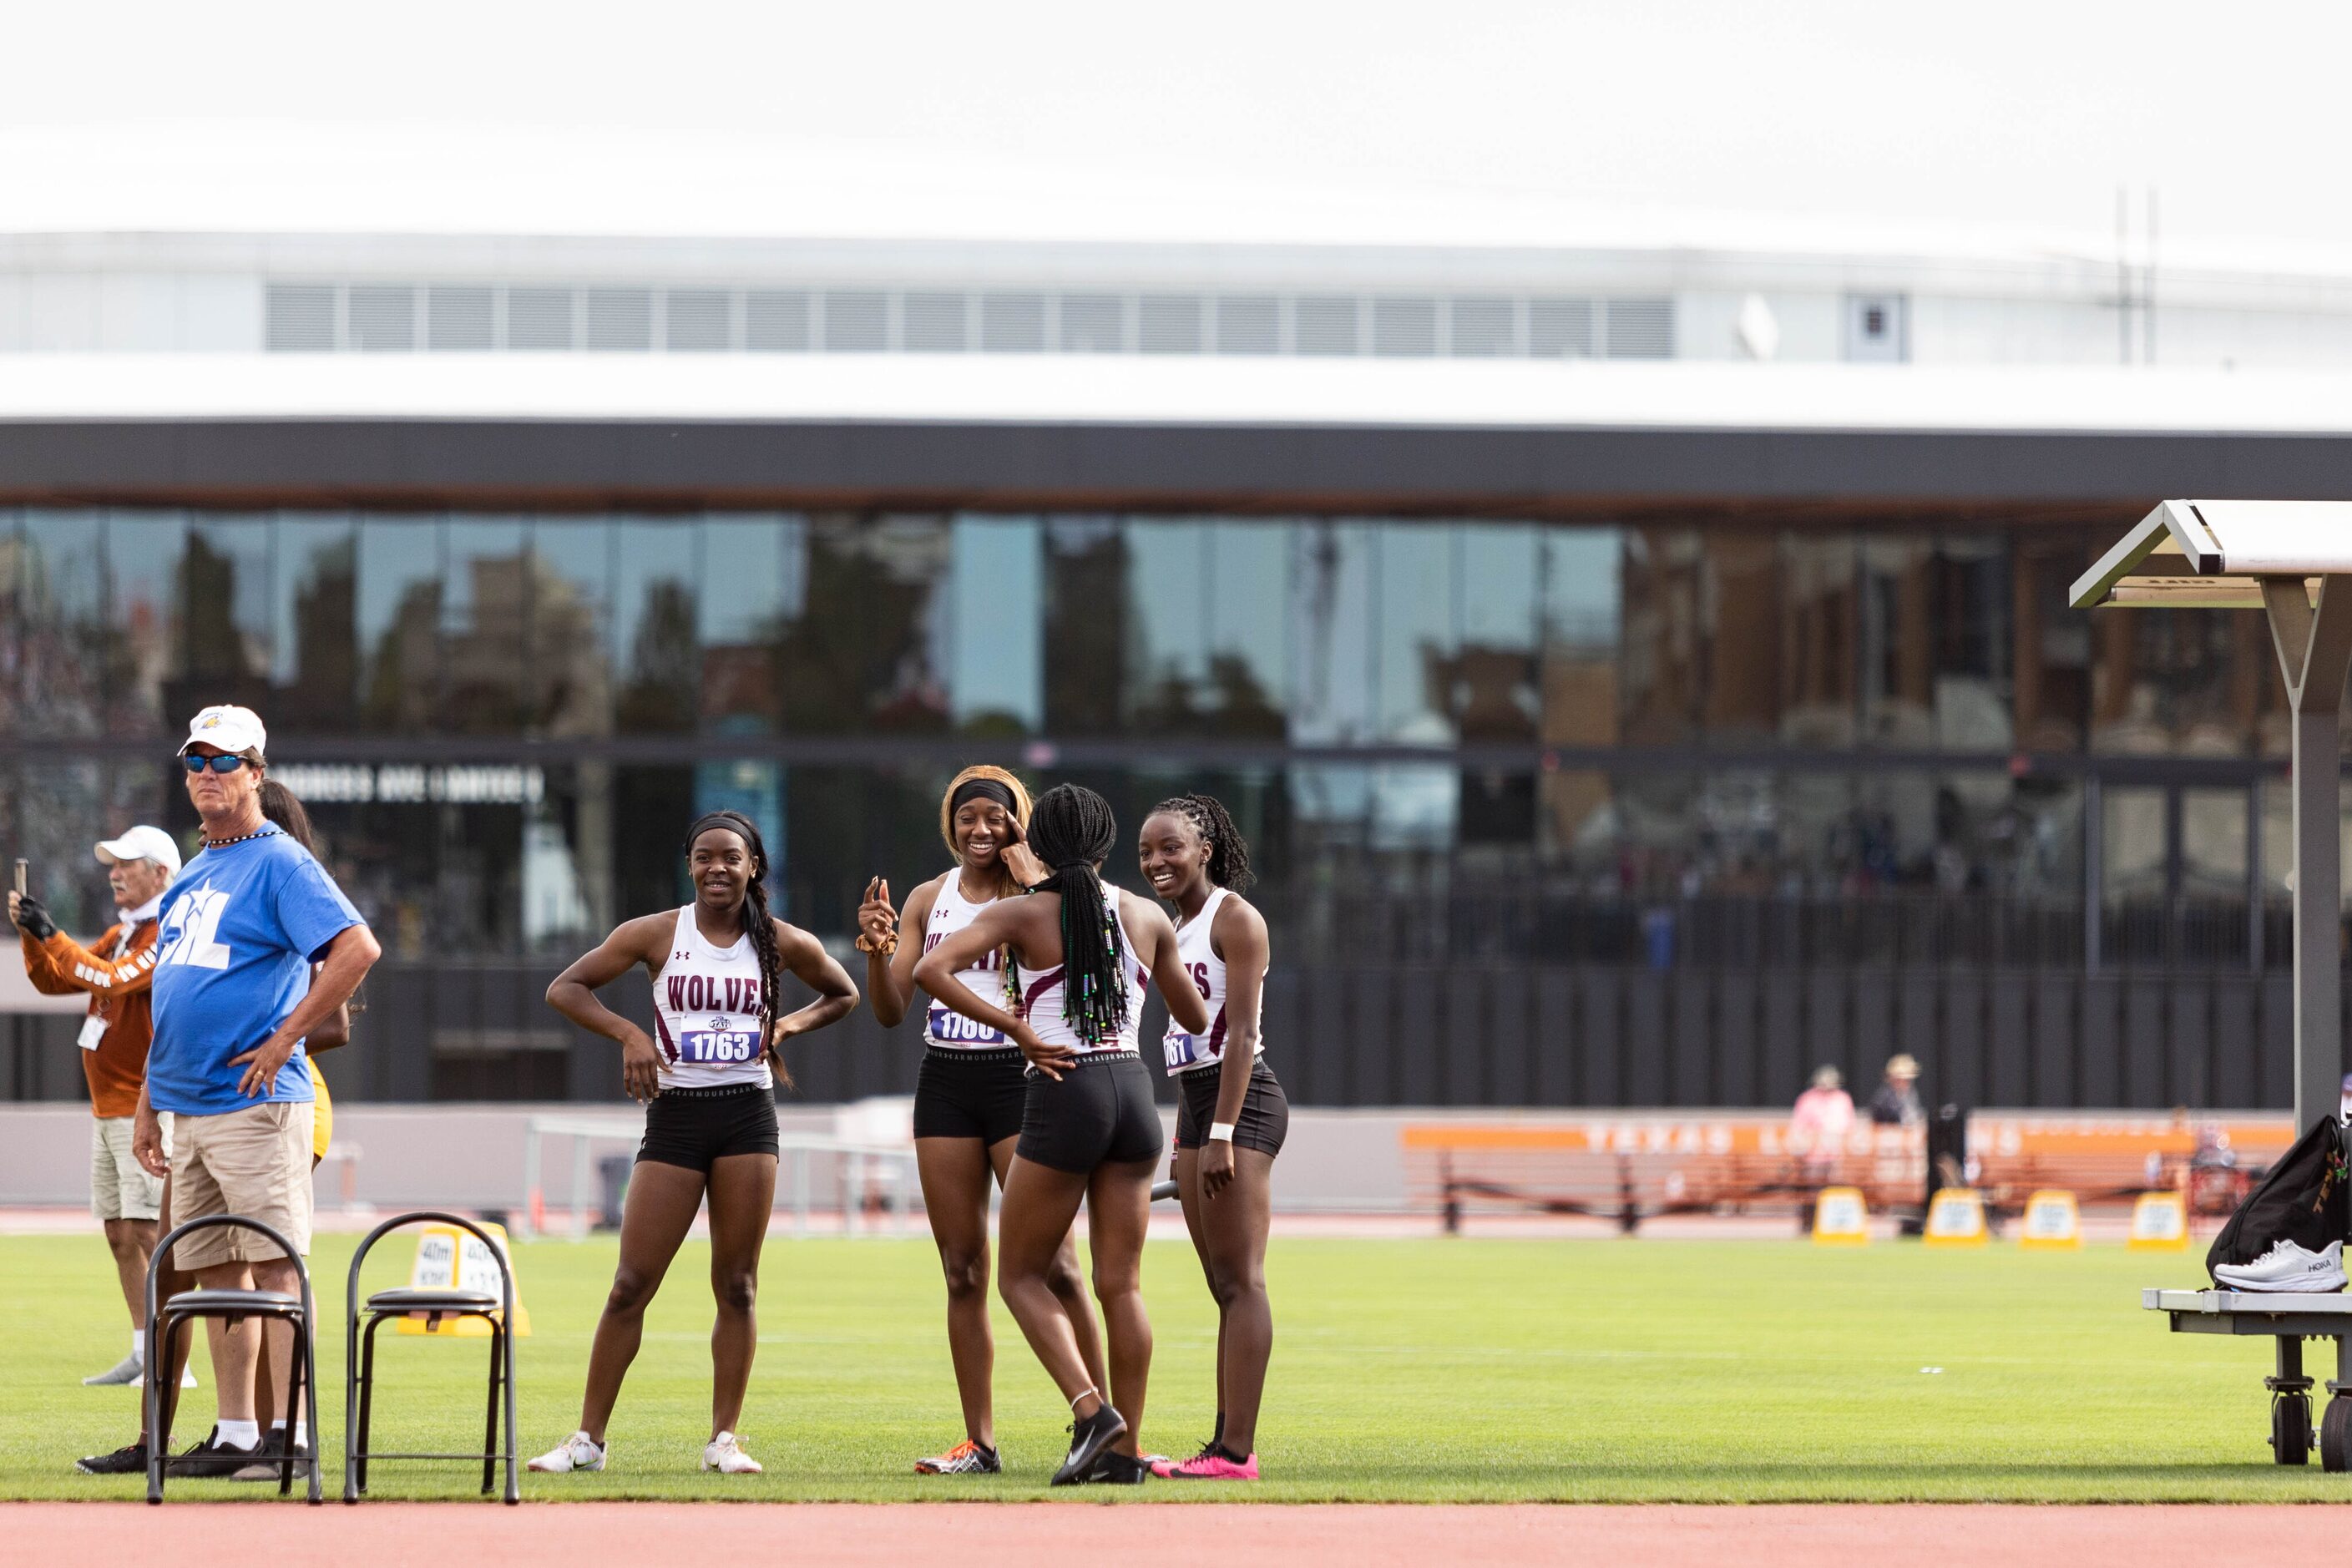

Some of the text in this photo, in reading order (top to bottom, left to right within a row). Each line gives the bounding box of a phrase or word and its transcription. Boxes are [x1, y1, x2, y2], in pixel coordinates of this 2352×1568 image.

[690, 1033, 750, 1060] 1763
[682, 1090, 724, 1098] ARMOUR
[1586, 1126, 1733, 1154] TEXAS
[2308, 1259, 2332, 1273] HOKA
